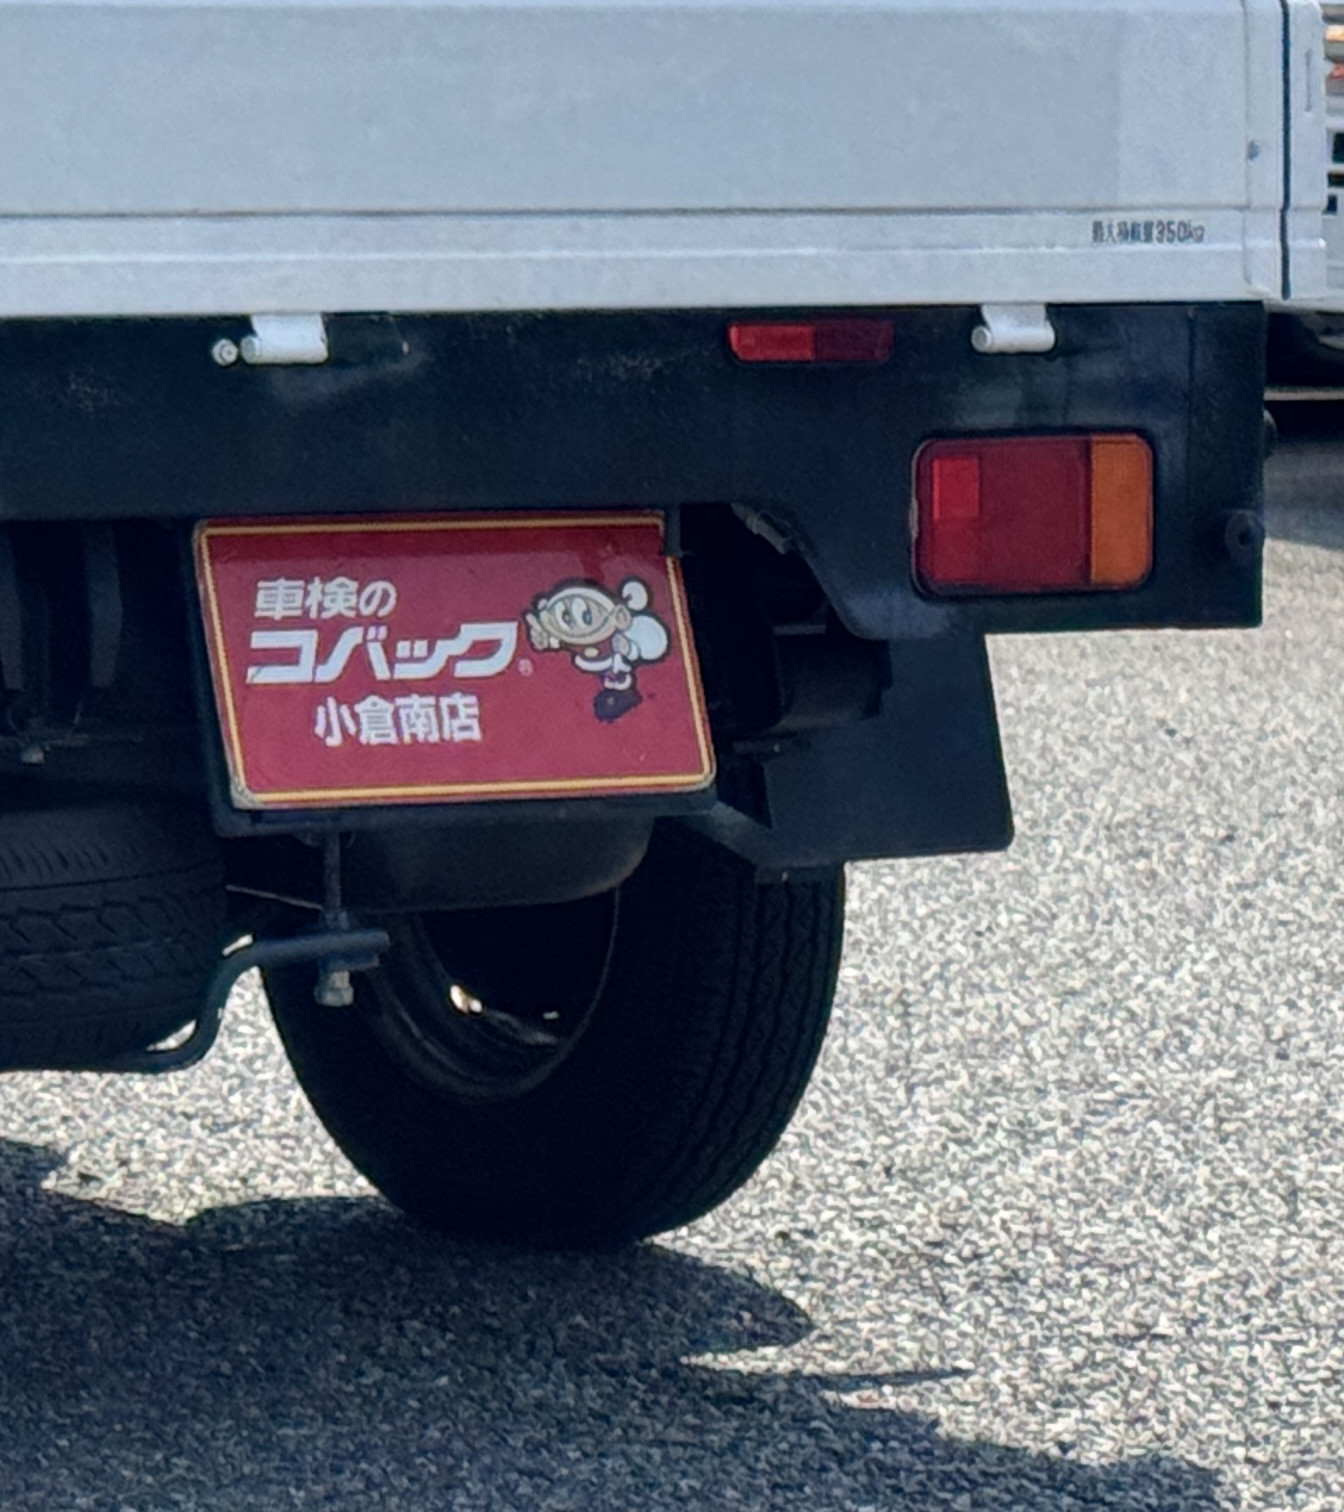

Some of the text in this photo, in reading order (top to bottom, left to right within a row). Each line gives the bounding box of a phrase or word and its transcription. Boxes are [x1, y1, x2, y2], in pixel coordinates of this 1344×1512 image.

[253, 576, 397, 620] 車検の
[245, 620, 518, 685] コバック
[314, 692, 482, 747] 小倉南店
